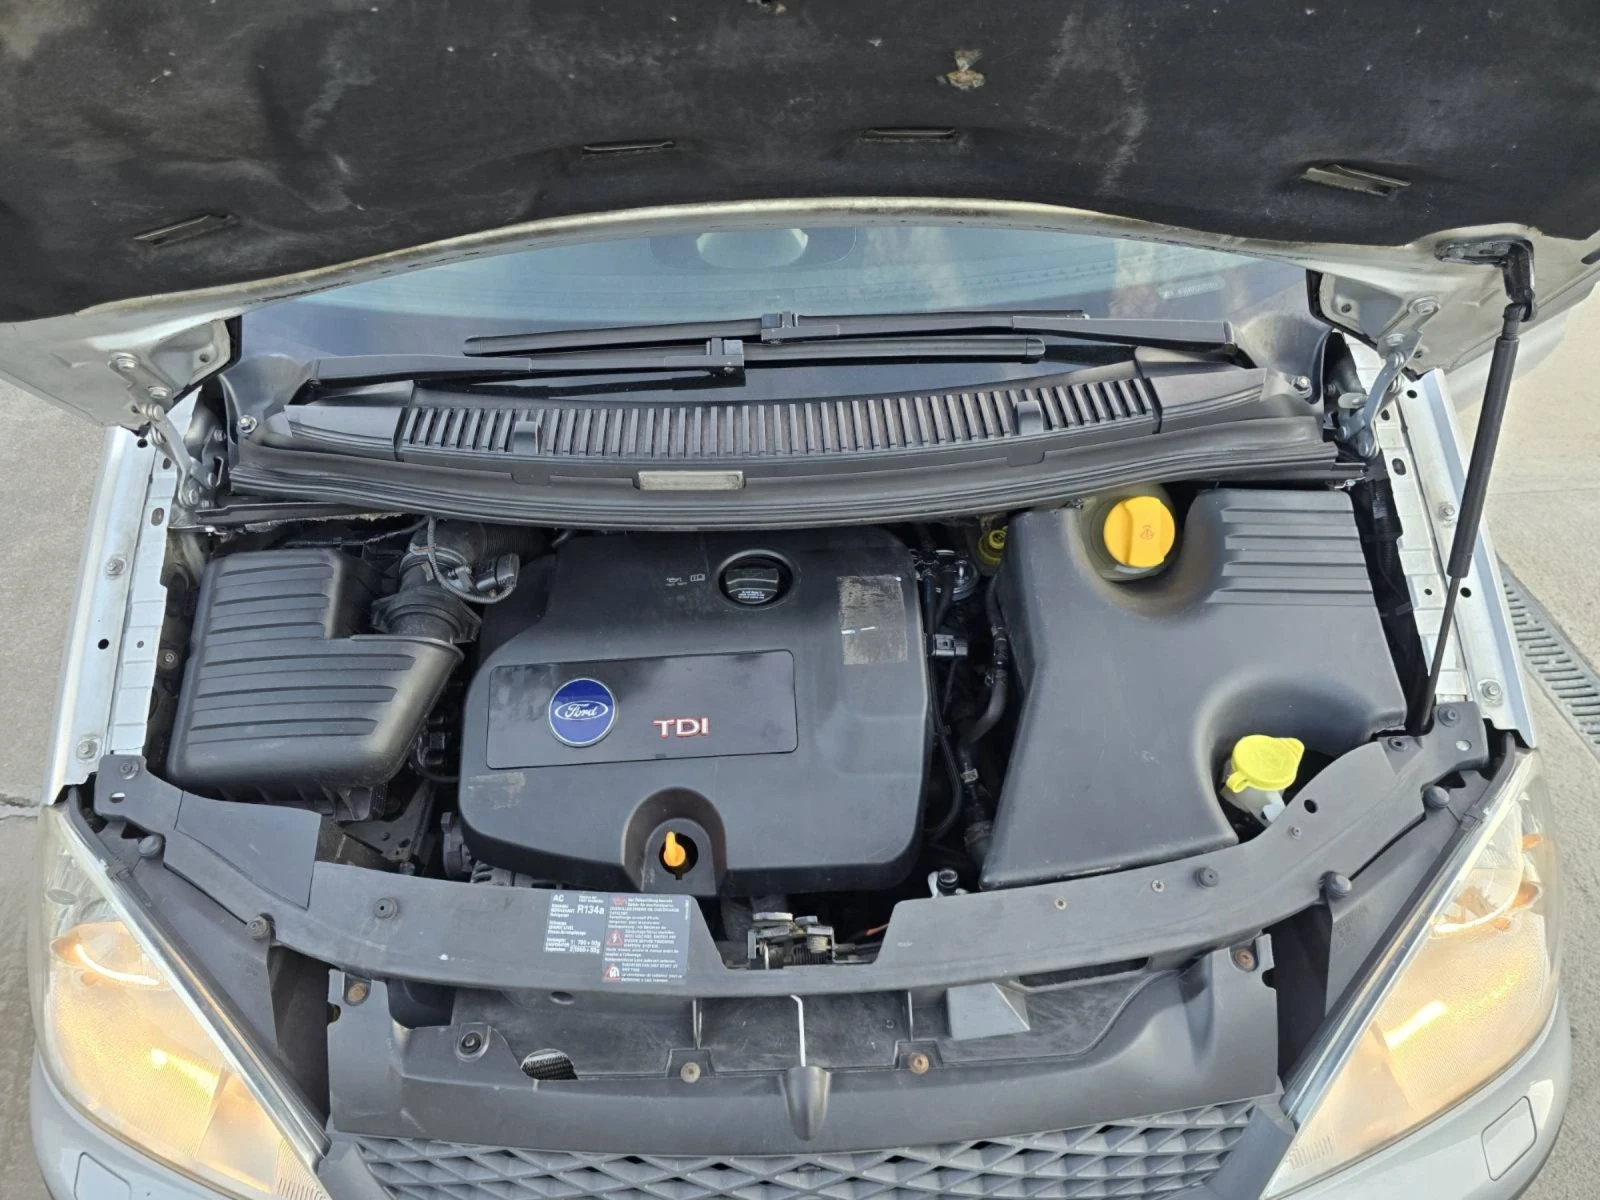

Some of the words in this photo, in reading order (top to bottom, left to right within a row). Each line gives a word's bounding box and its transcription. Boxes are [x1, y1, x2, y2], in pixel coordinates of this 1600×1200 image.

[564, 703, 598, 719] Ford
[653, 717, 710, 739] TDI
[553, 894, 565, 902] AC
[577, 904, 605, 915] R134a
